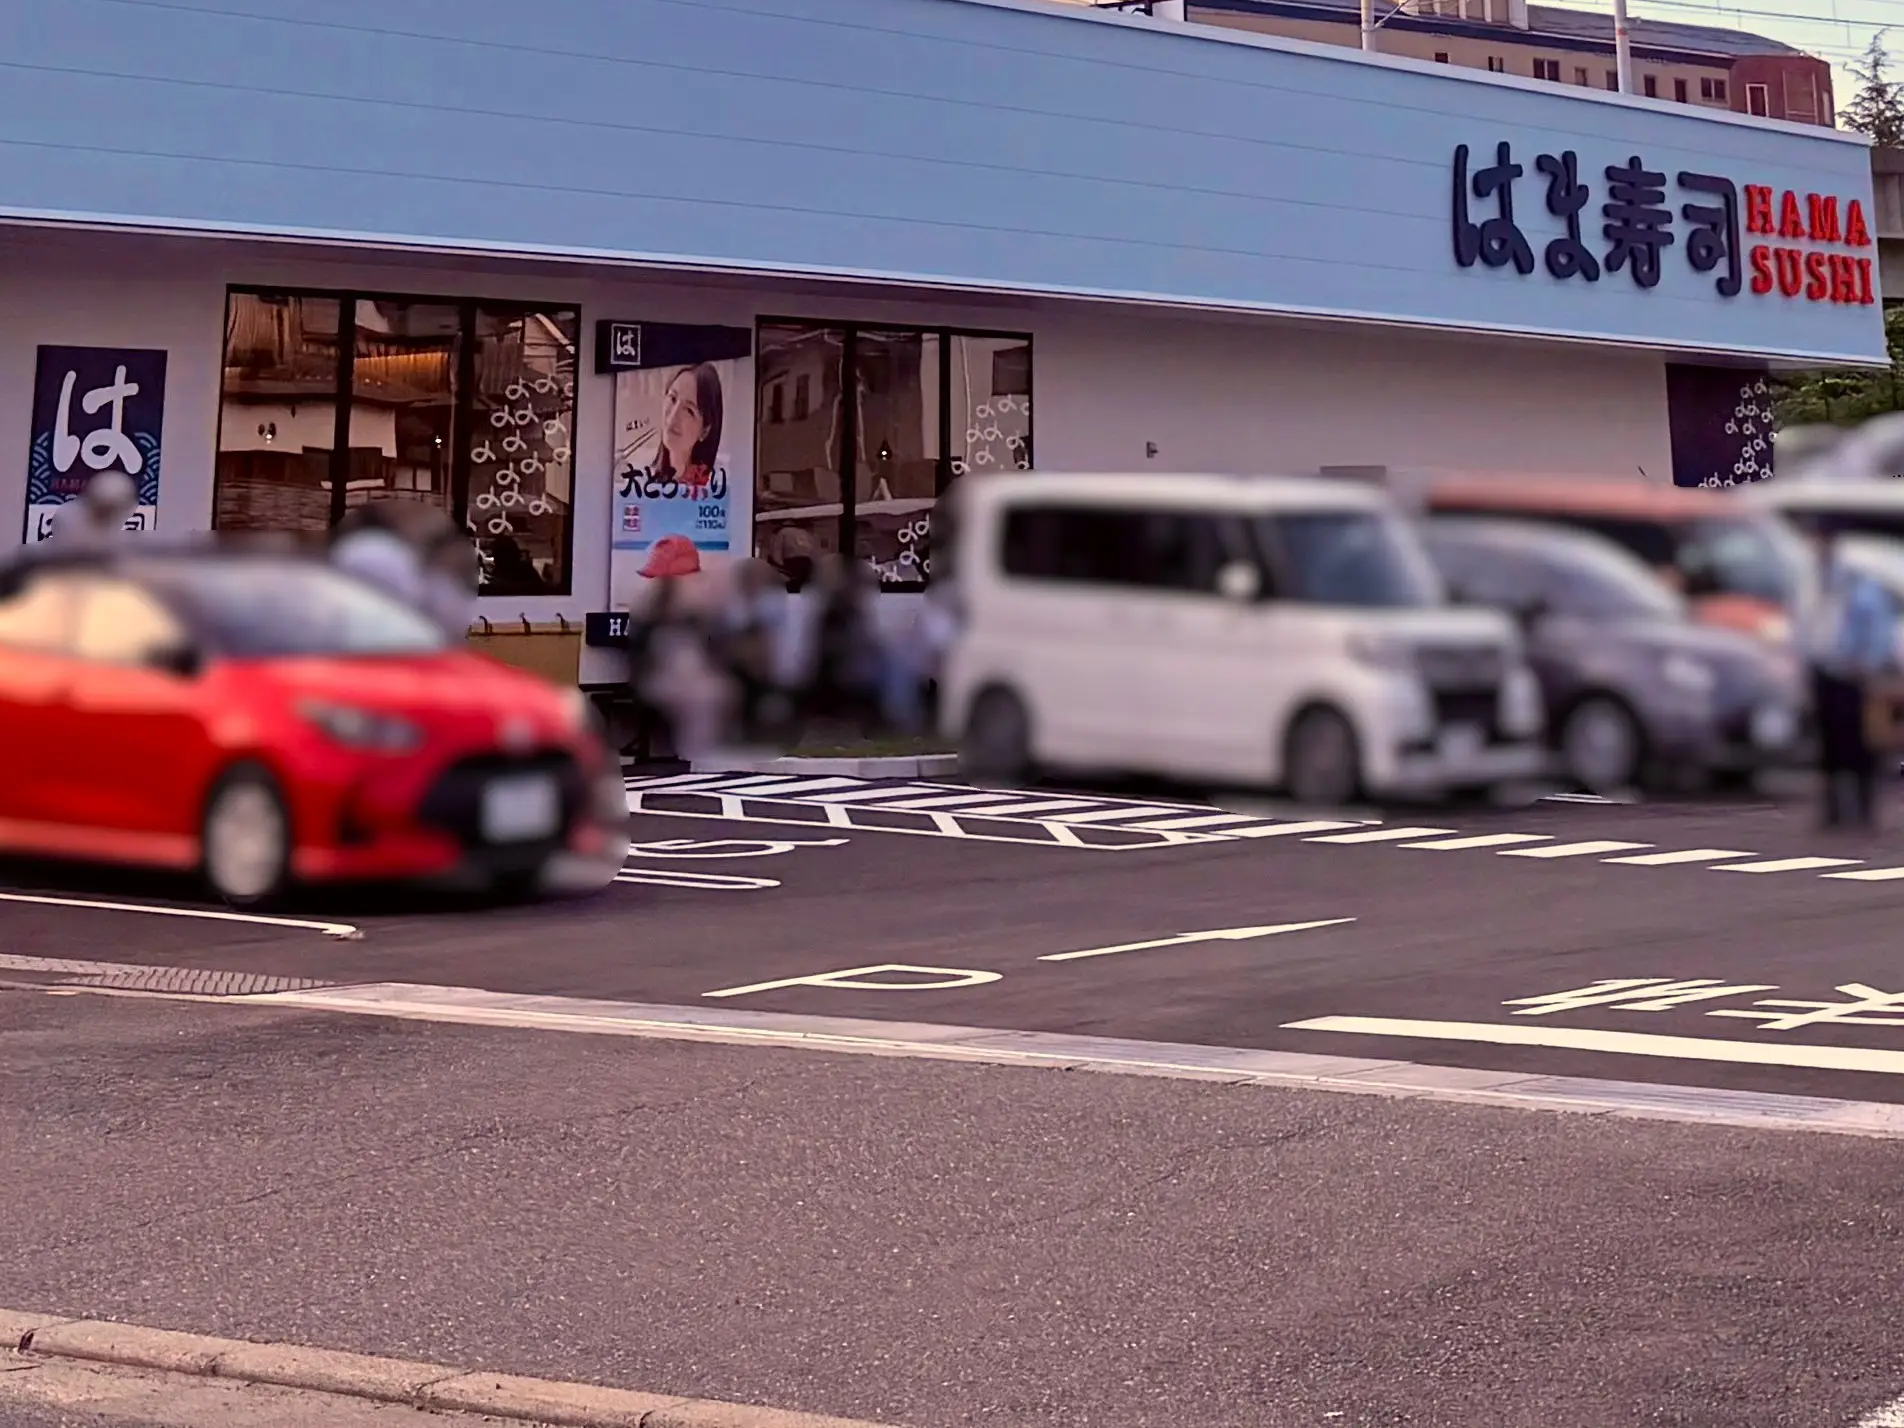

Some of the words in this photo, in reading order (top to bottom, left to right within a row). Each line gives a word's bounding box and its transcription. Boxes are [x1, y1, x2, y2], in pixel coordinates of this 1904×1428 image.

[1453, 141, 1742, 297] はま寿司
[1743, 183, 1871, 247] HAMA
[1751, 245, 1875, 305] SUSHI
[615, 330, 636, 356] は
[53, 365, 143, 475] は
